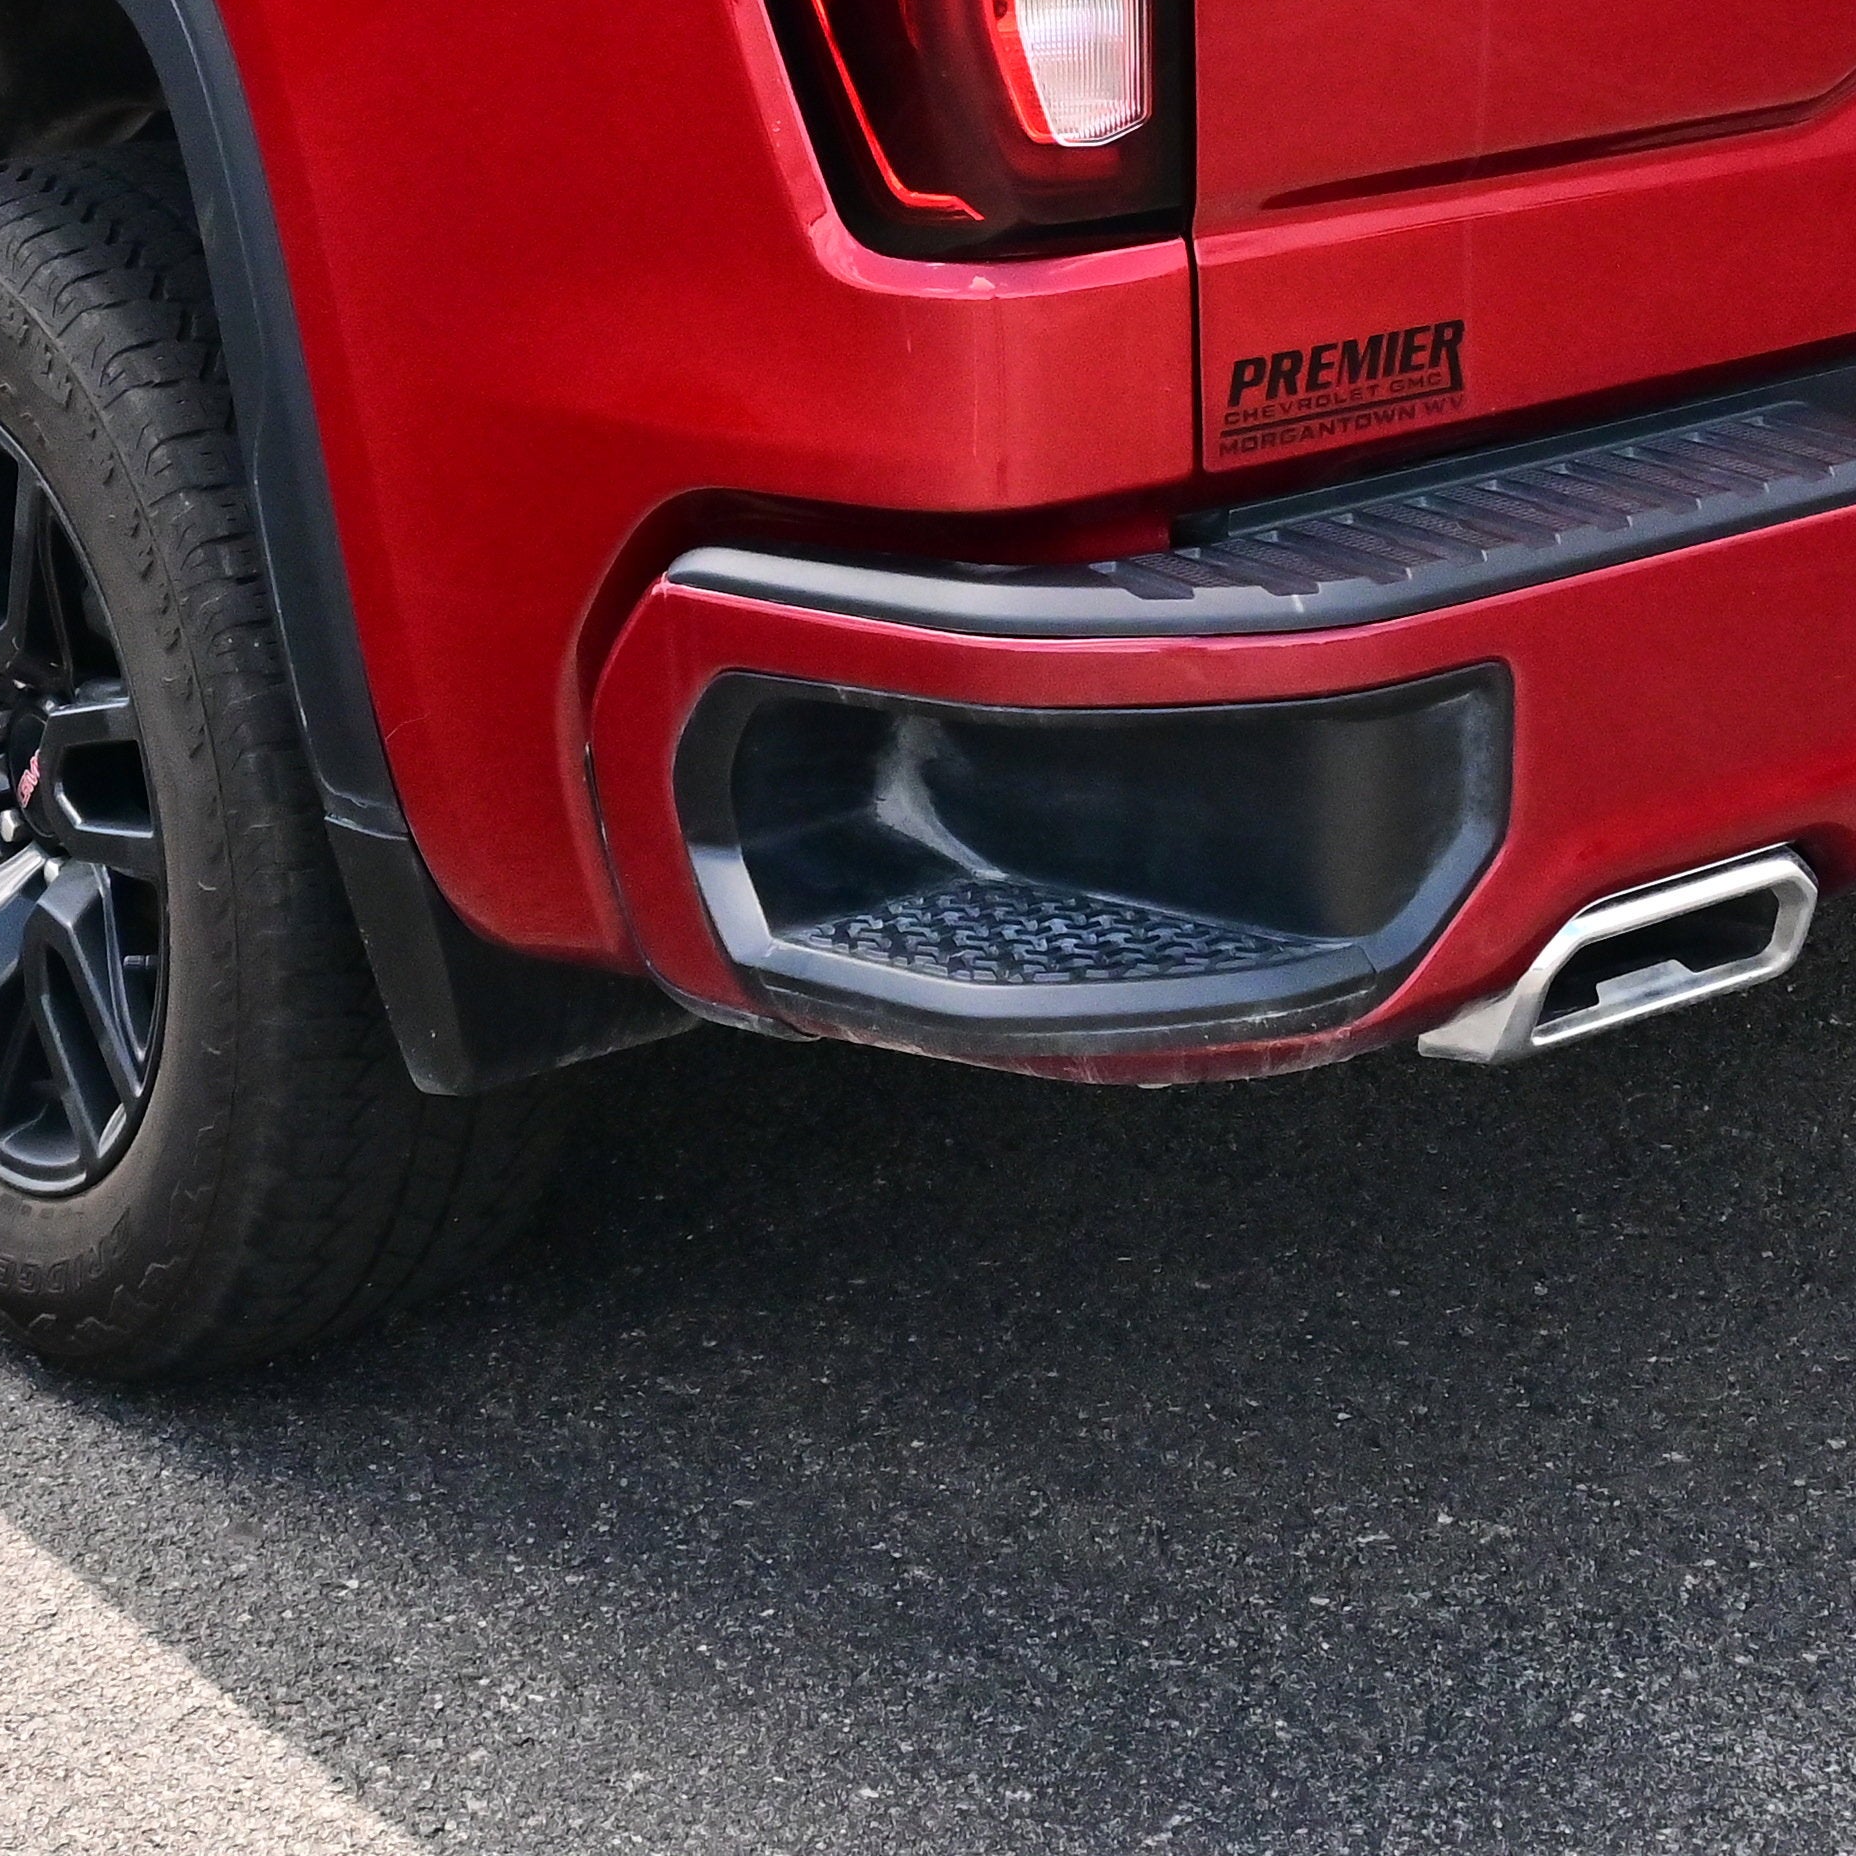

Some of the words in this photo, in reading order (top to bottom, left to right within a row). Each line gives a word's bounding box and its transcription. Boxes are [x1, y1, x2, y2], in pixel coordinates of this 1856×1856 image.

[1226, 318, 1466, 408] PREMIER
[1218, 404, 1417, 458] MORGANTOWN
[1422, 394, 1465, 416] WV
[1223, 383, 1380, 426] CHEVROLET
[1388, 370, 1443, 394] GMC
